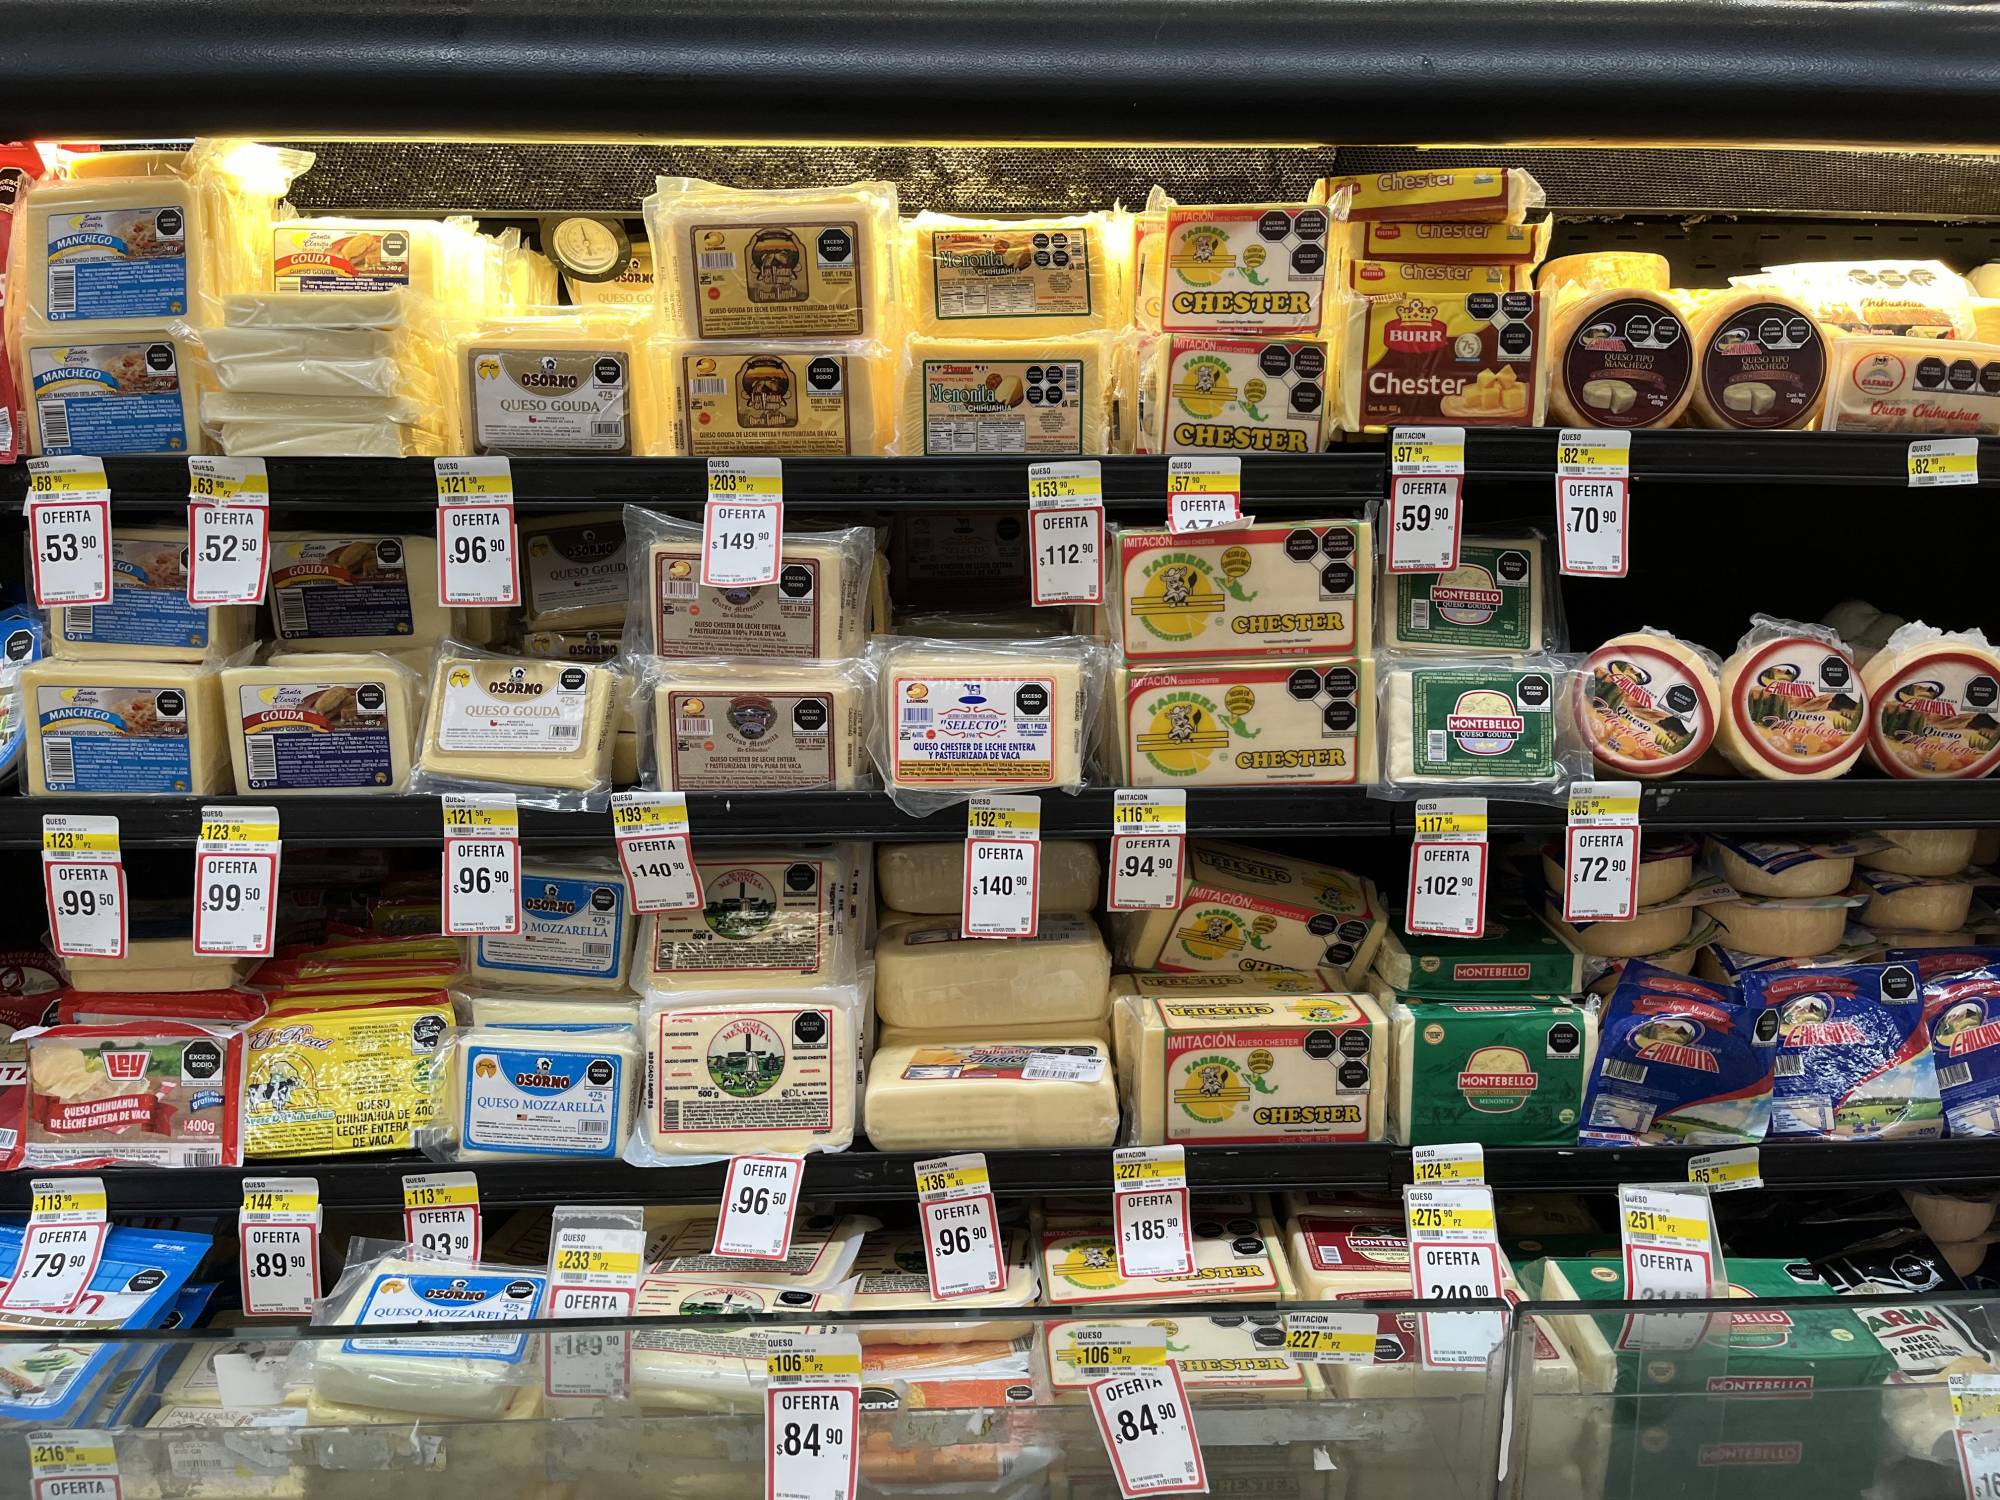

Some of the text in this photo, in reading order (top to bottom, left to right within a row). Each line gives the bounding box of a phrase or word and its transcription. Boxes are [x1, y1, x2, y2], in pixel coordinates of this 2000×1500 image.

[1377, 173, 1455, 192] Chester
[1171, 210, 1214, 222] IMITACIÓN
[1416, 222, 1492, 239] Chester
[56, 233, 113, 247] MANCHEGO
[290, 253, 331, 265] GOUDA
[939, 250, 1004, 268] Menonita
[1400, 264, 1473, 281] Chester
[1172, 290, 1311, 315] CHESTER
[1389, 329, 1443, 343] BURR
[1173, 338, 1216, 351] IMITACIÓN
[1604, 353, 1655, 363] QUESO TIPO
[1604, 361, 1653, 370] MANCHEGO
[42, 368, 101, 380] MANCHEGO
[521, 371, 578, 388] OSORNO
[1368, 372, 1466, 396] Chester
[930, 384, 996, 403] Menonita
[501, 399, 600, 413] QUESO GOUDA
[1870, 400, 1981, 422] Queso Chihuahua
[1174, 423, 1309, 453] CHESTER
[1394, 432, 1426, 440] IMITACION
[708, 460, 730, 468] QUESO
[1402, 482, 1447, 495] OFERTA
[1569, 484, 1614, 497] OFERTA
[1180, 499, 1226, 513] OFERTA
[42, 511, 92, 525] OFERTA
[204, 512, 254, 526] OFERTA
[452, 513, 500, 527] OFERTA
[718, 508, 766, 520] OFERTA
[1042, 516, 1089, 531] OFERTA
[1123, 534, 1173, 547] IMITACIÓN
[288, 564, 330, 577] GOUDA
[1141, 552, 1214, 578] FARMERS
[1433, 588, 1500, 603] MONTEBELLO
[1442, 601, 1491, 610] QUESO GOUDA
[1231, 611, 1345, 635] CHESTER
[1130, 672, 1178, 688] IMITACIÓN
[488, 681, 543, 695] OSORNO
[49, 708, 110, 722] MANCHEGO
[261, 710, 305, 722] GOUDA
[465, 704, 560, 717] QUESO GOUDA
[1787, 709, 1826, 723] Queso
[1450, 718, 1520, 730] MONTEBELLO
[1460, 731, 1512, 739] QUESO GOUDA
[1922, 725, 1962, 740] Queso
[913, 742, 1036, 752] QUESO CHESTER DE LECHE ENTERA
[929, 751, 1021, 760] Y PASTEURIZADA DE VACA
[1235, 747, 1346, 769] CHESTER
[628, 840, 676, 853] OFERTA
[1125, 839, 1171, 849] OFERTA
[1579, 835, 1624, 848] OFERTA
[457, 845, 505, 858] OFERTA
[978, 848, 1024, 860] OFERTA
[1424, 850, 1470, 862] OFERTA
[208, 861, 258, 874] OFERTA
[58, 868, 108, 882] OFERTA
[1189, 886, 1253, 909] IMITACIÓN
[530, 922, 608, 938] MOZZARELLA
[1457, 967, 1527, 977] MONTEBELLO
[722, 1027, 772, 1042] MENONITA
[1167, 1031, 1298, 1049] IMITACIÓN QUESO CHESTER
[515, 1072, 570, 1089] OSORNO
[1460, 1075, 1534, 1087] MONTEBELLO
[64, 1098, 139, 1118] QUESO CHIHUAHUA
[356, 1099, 391, 1111] QUESO
[477, 1097, 605, 1113] QUESO MOZZARELLA
[50, 1110, 151, 1129] DE LECHE ENTERA DE VACA
[335, 1109, 411, 1126] CHIHUAHUA DE
[1253, 1105, 1361, 1125] CHESTER
[336, 1121, 410, 1137] LECHE ENTERA
[352, 1134, 395, 1148] DE VACA
[1115, 1150, 1146, 1159] IMITACION
[743, 1163, 787, 1179] OFERTA
[917, 1161, 948, 1170] IMITACION
[1127, 1194, 1173, 1208] OFERTA
[1410, 1193, 1433, 1201] QUESO
[934, 1204, 980, 1221] OFERTA
[38, 1230, 87, 1244] OFERTA
[252, 1230, 301, 1245] OFERTA
[562, 1233, 586, 1242] QUESO
[1426, 1251, 1480, 1266] OFERTA
[1640, 1253, 1694, 1273] OFERTA
[424, 1286, 487, 1301] OSORNO
[564, 1294, 618, 1310] OFERTA
[374, 1306, 520, 1322] QUESO MOZZARELLA
[1289, 1315, 1329, 1324] IMITACION
[1866, 1308, 1949, 1332] ARMA
[1077, 1331, 1103, 1339] QUESO
[767, 1339, 793, 1347] QUESO
[782, 1394, 840, 1411] OFERTA
[50, 1480, 105, 1496] OFERTA
